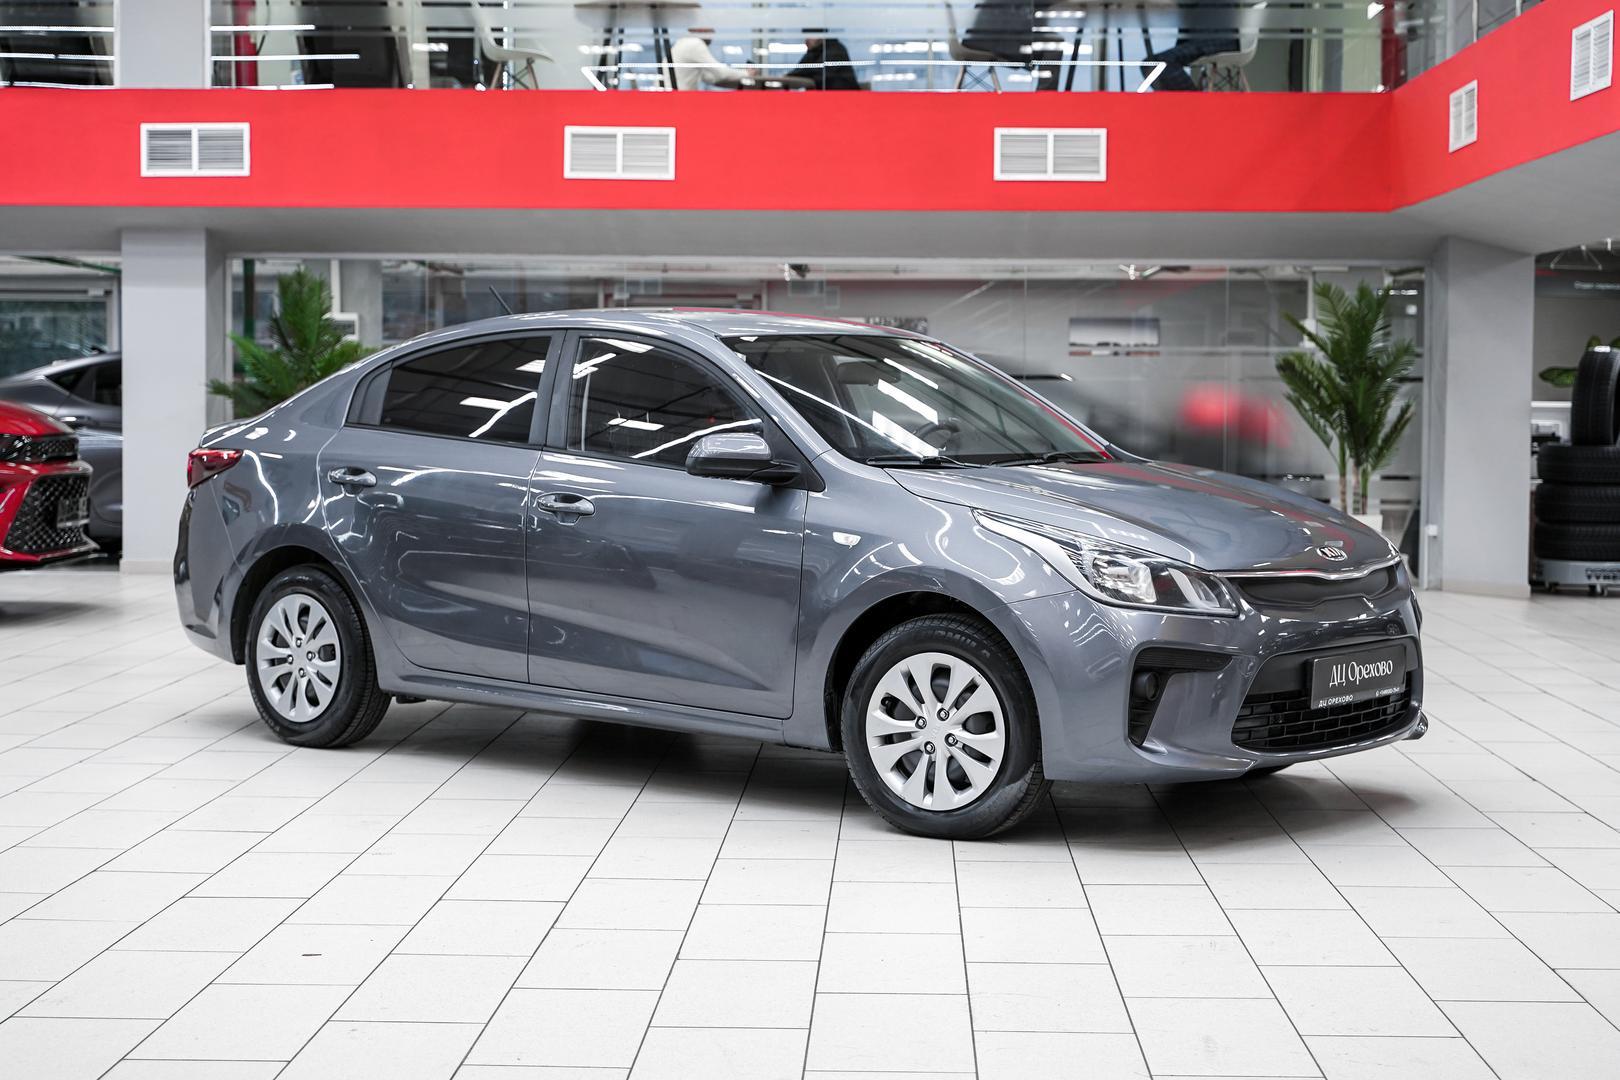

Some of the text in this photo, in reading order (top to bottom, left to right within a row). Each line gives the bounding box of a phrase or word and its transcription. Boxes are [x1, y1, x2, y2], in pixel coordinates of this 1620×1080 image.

[1329, 660, 1393, 688] ДЦ Орехово
[1318, 695, 1353, 708] ДЦ ОРЕХОВО
